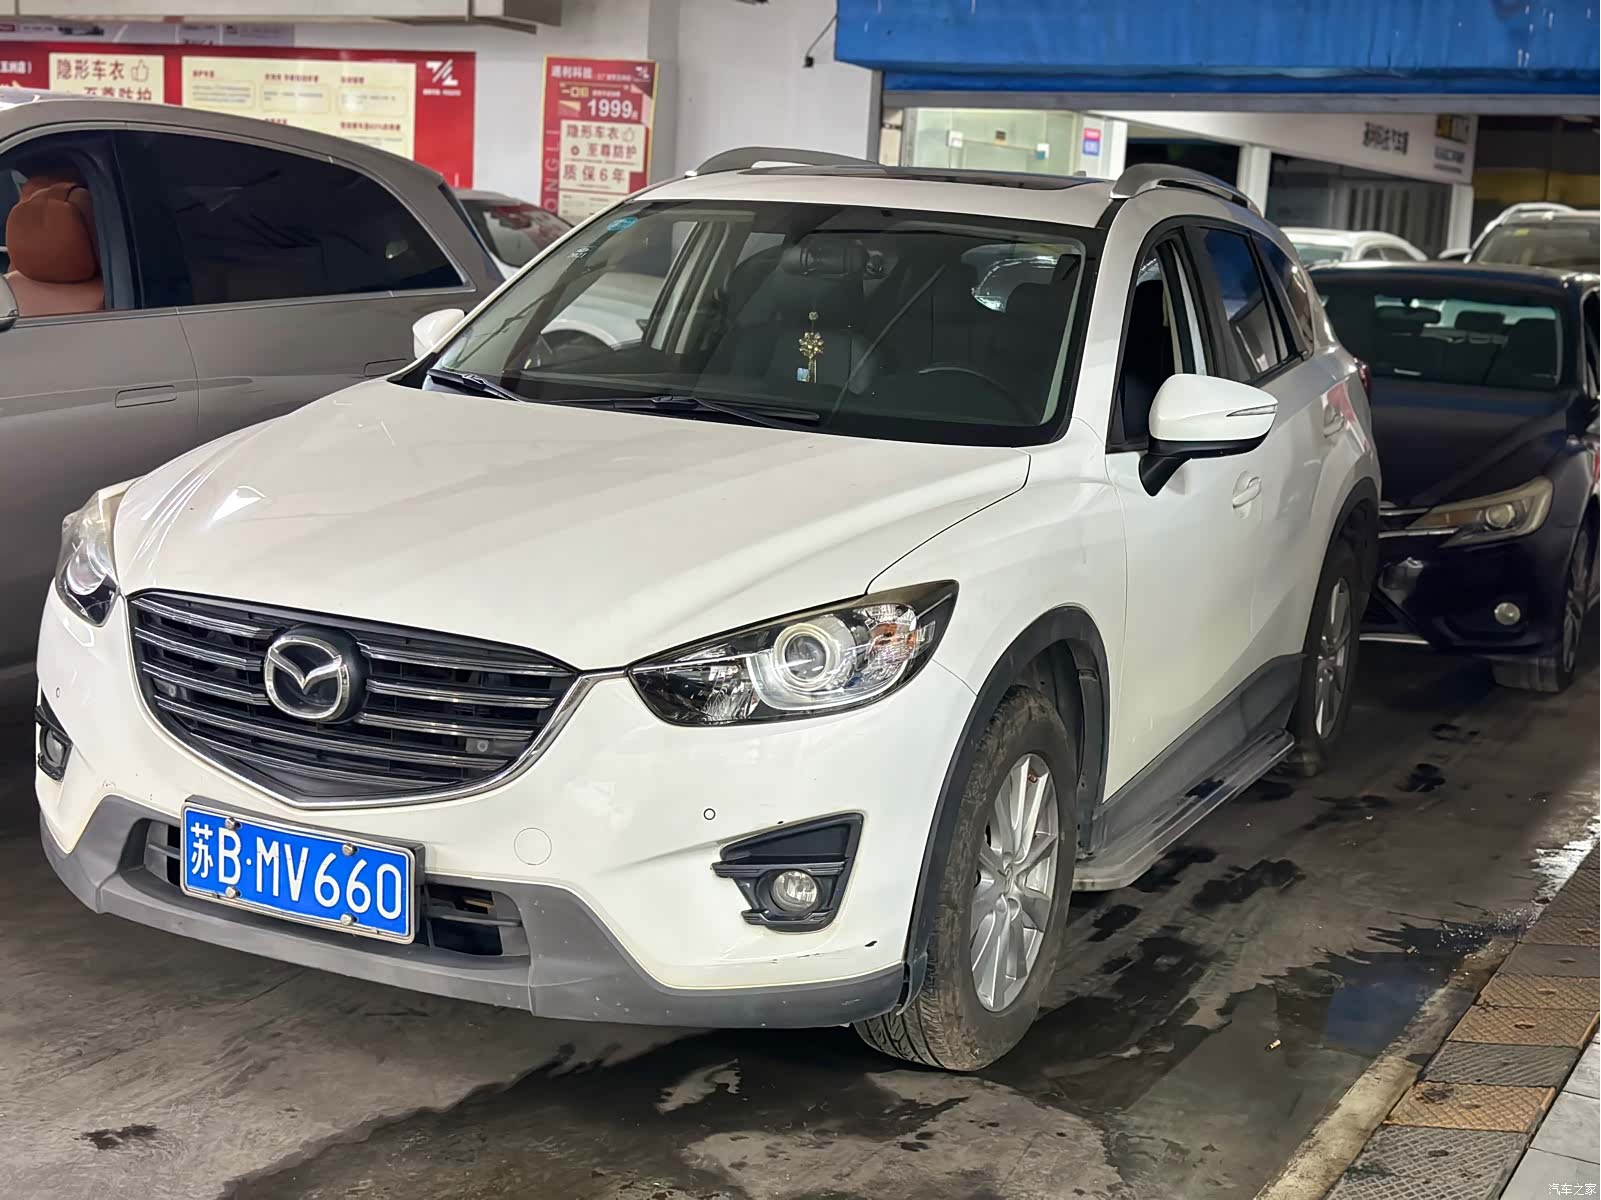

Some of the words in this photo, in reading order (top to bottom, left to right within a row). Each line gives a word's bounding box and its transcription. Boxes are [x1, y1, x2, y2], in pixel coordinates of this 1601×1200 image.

[56, 59, 126, 80] 隐形车衣
[566, 124, 620, 141] 隐形车衣
[587, 142, 637, 160] 至尊防护
[563, 164, 625, 183] 质保6年
[190, 821, 402, 921] 苏B·MV660
